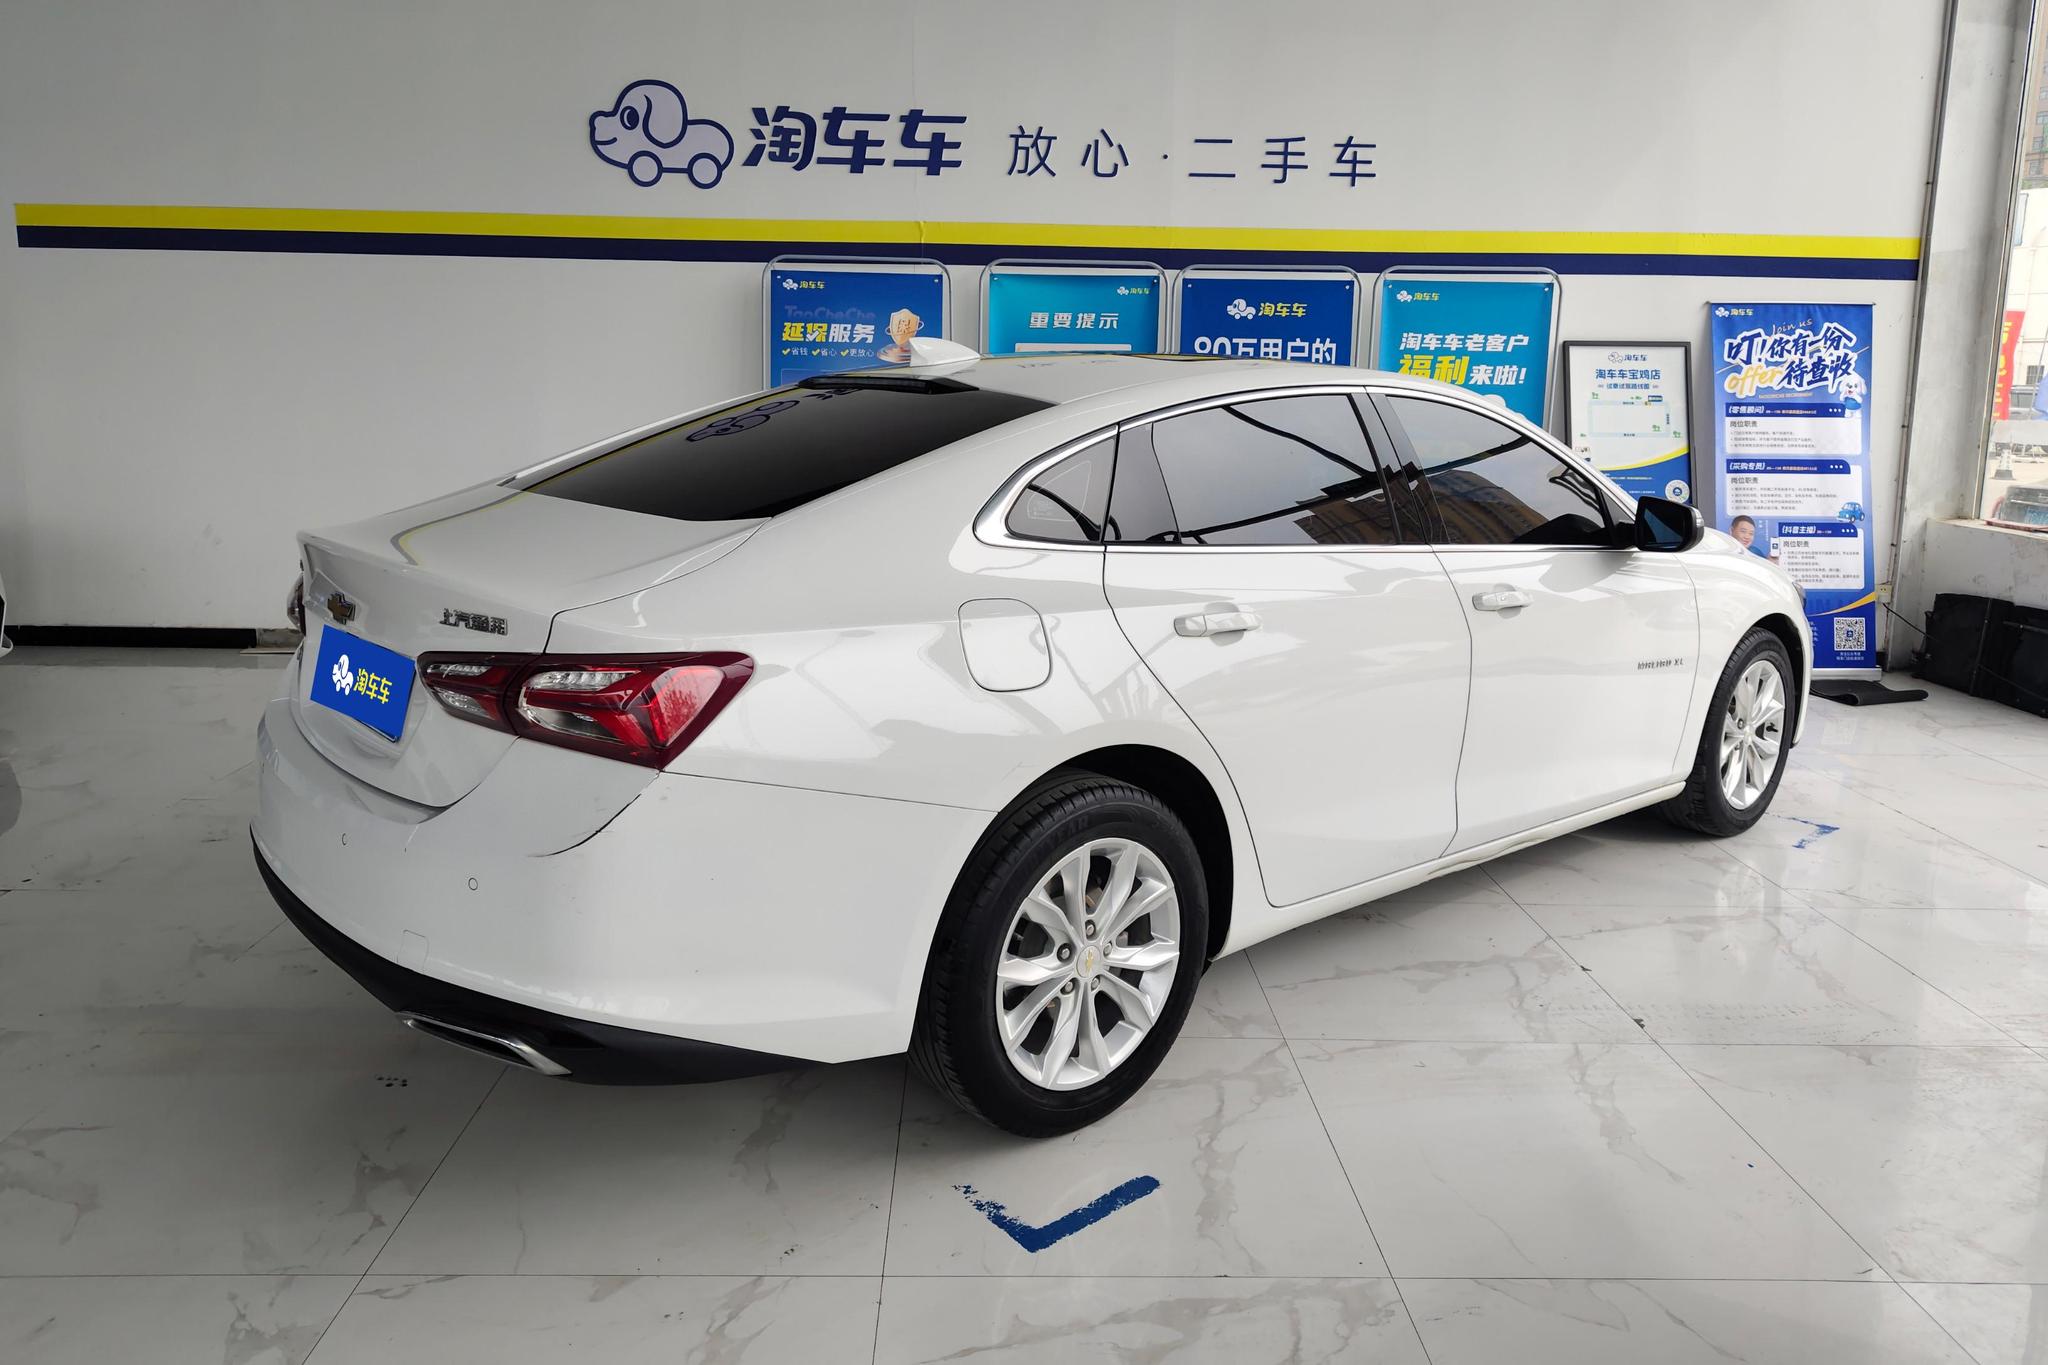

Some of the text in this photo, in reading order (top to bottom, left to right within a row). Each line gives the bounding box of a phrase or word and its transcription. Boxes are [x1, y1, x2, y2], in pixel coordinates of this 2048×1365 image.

[742, 105, 968, 177] 淘车车
[799, 280, 825, 290] 淘车车
[1413, 292, 1440, 301] 淘车车
[1258, 302, 1308, 318] 淘车车
[1029, 311, 1120, 329] 重要提示
[1799, 318, 1813, 328] us
[782, 322, 876, 344] 延保服务
[1194, 336, 1337, 365] 90万用户的
[1399, 332, 1530, 352] 淘车车老客户
[791, 347, 876, 358] 省钱 省心 更放心
[1595, 368, 1661, 380] 淘车车宝鸡店
[1726, 364, 1784, 396] offer
